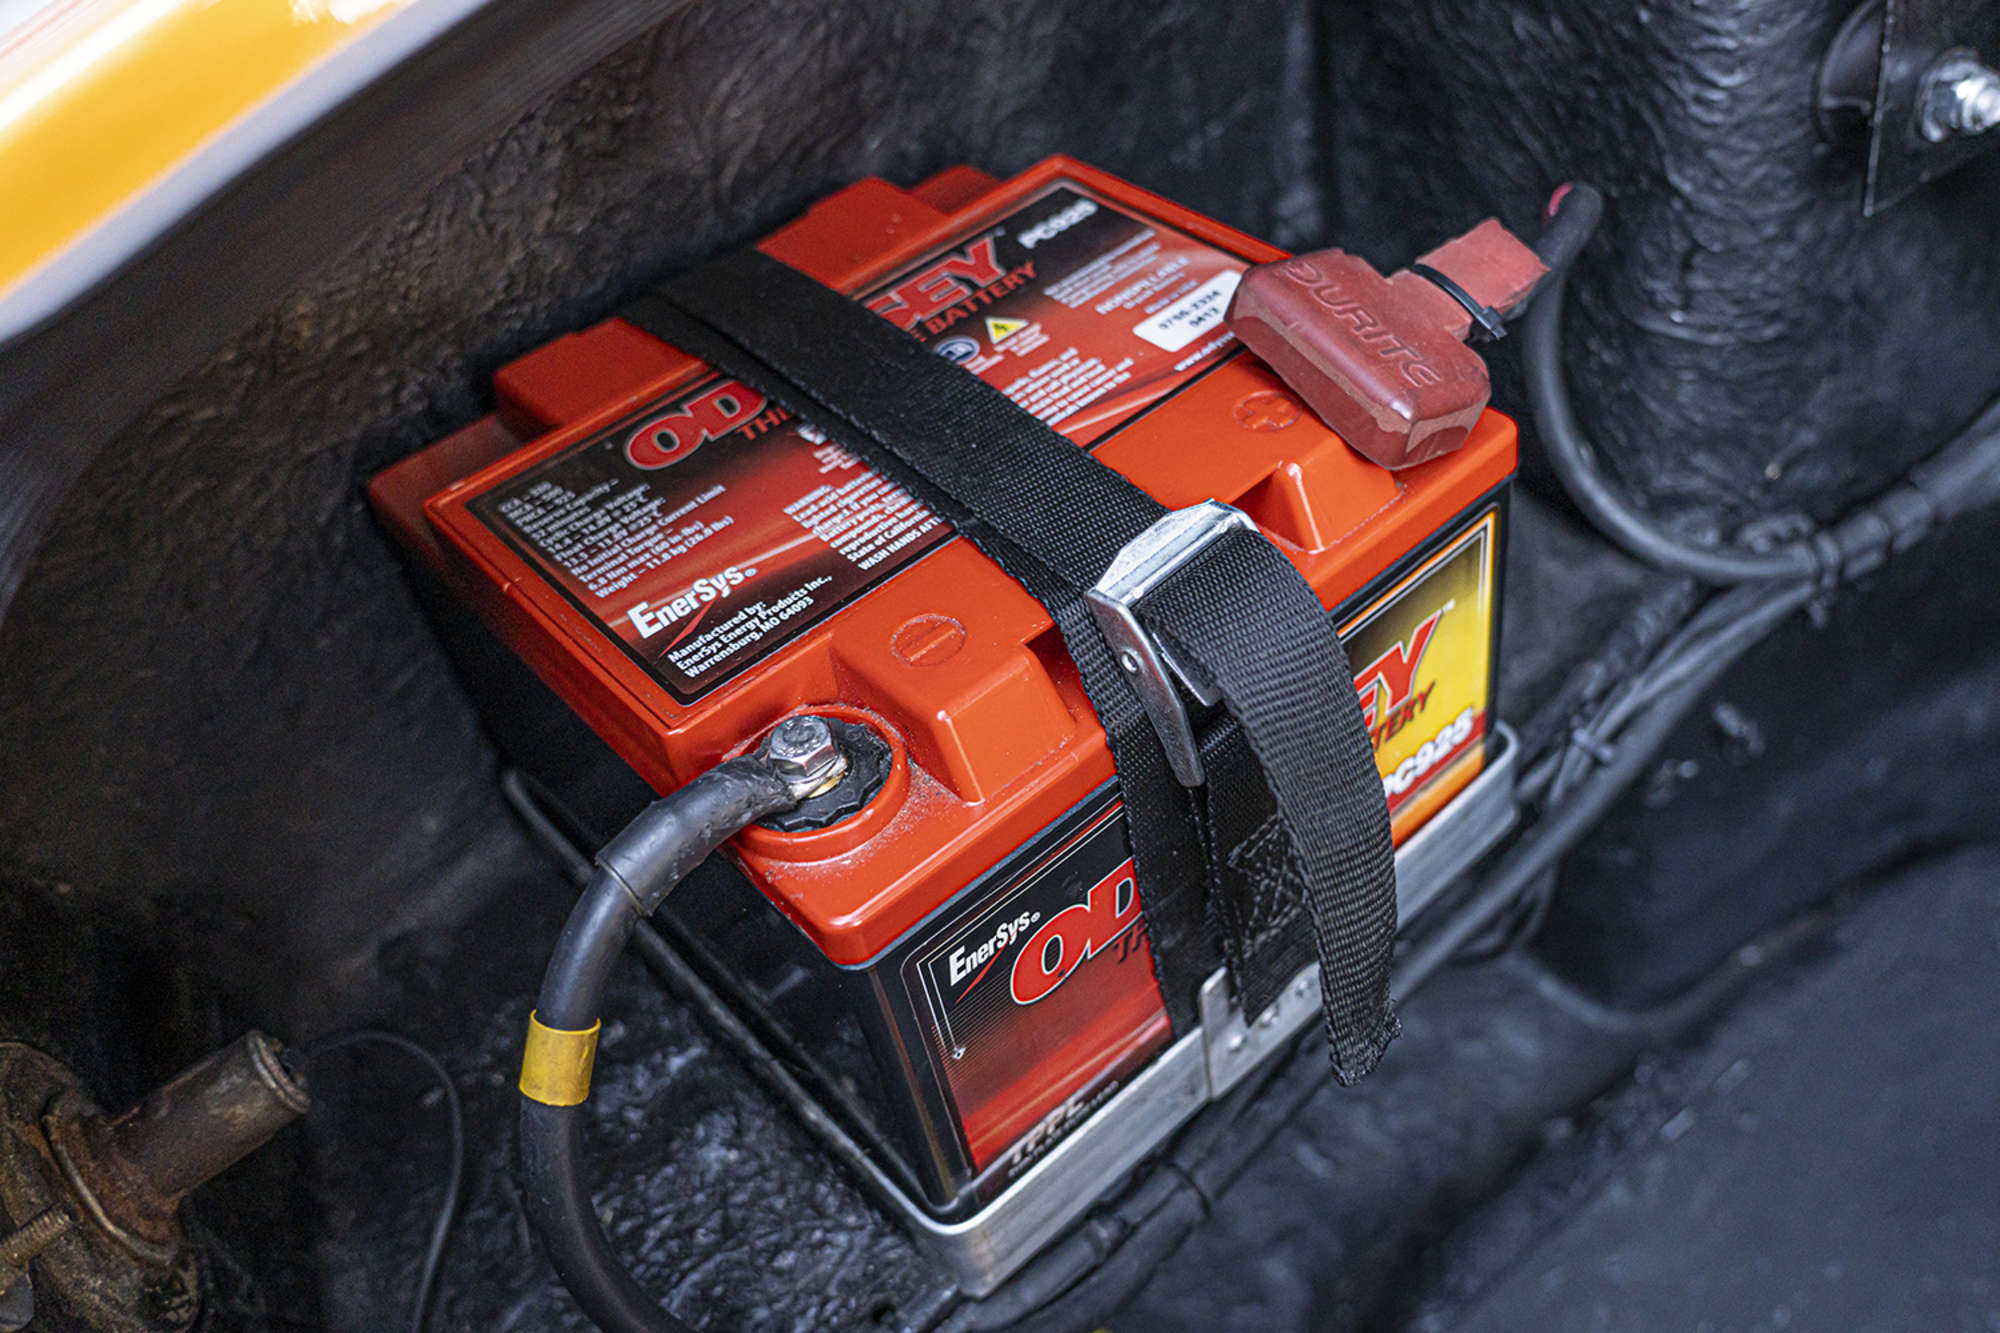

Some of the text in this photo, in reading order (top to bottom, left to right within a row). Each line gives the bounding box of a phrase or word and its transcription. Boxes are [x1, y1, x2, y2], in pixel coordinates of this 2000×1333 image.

[924, 259, 1037, 334] BATTERY
[1284, 260, 1441, 388] DURITE
[625, 378, 768, 470] OD
[523, 508, 566, 533] Reserve
[565, 484, 610, 510] Capacity
[547, 506, 590, 532] minutes
[801, 478, 882, 528] lighted cigarettes
[859, 492, 878, 507] you
[539, 529, 569, 547] Cyclic
[568, 509, 606, 531] Charge
[554, 543, 584, 561] Float
[583, 522, 621, 545] Charge
[570, 485, 725, 576] No Initial Charge Current Limit
[830, 513, 887, 548] compounds,
[838, 517, 899, 555] reproductive
[847, 543, 875, 562] State
[883, 510, 929, 539] California
[858, 549, 890, 569] WASH
[886, 529, 921, 552] HANDS
[578, 552, 629, 582] Terminal
[626, 533, 664, 555] Torque
[588, 577, 608, 590] 6.8
[606, 566, 628, 580] Nm
[627, 552, 652, 568] max
[650, 541, 670, 555] (60
[595, 572, 638, 598] Weight
[646, 552, 671, 568] 11.8
[669, 544, 687, 556] kg
[710, 516, 734, 531] lbs)
[668, 601, 766, 662] Manufactured by:
[676, 576, 832, 670] EnerSys Energy Products Inc.,
[684, 596, 814, 677] Warrensburg, MO 64093
[1010, 857, 1143, 1006] OD
